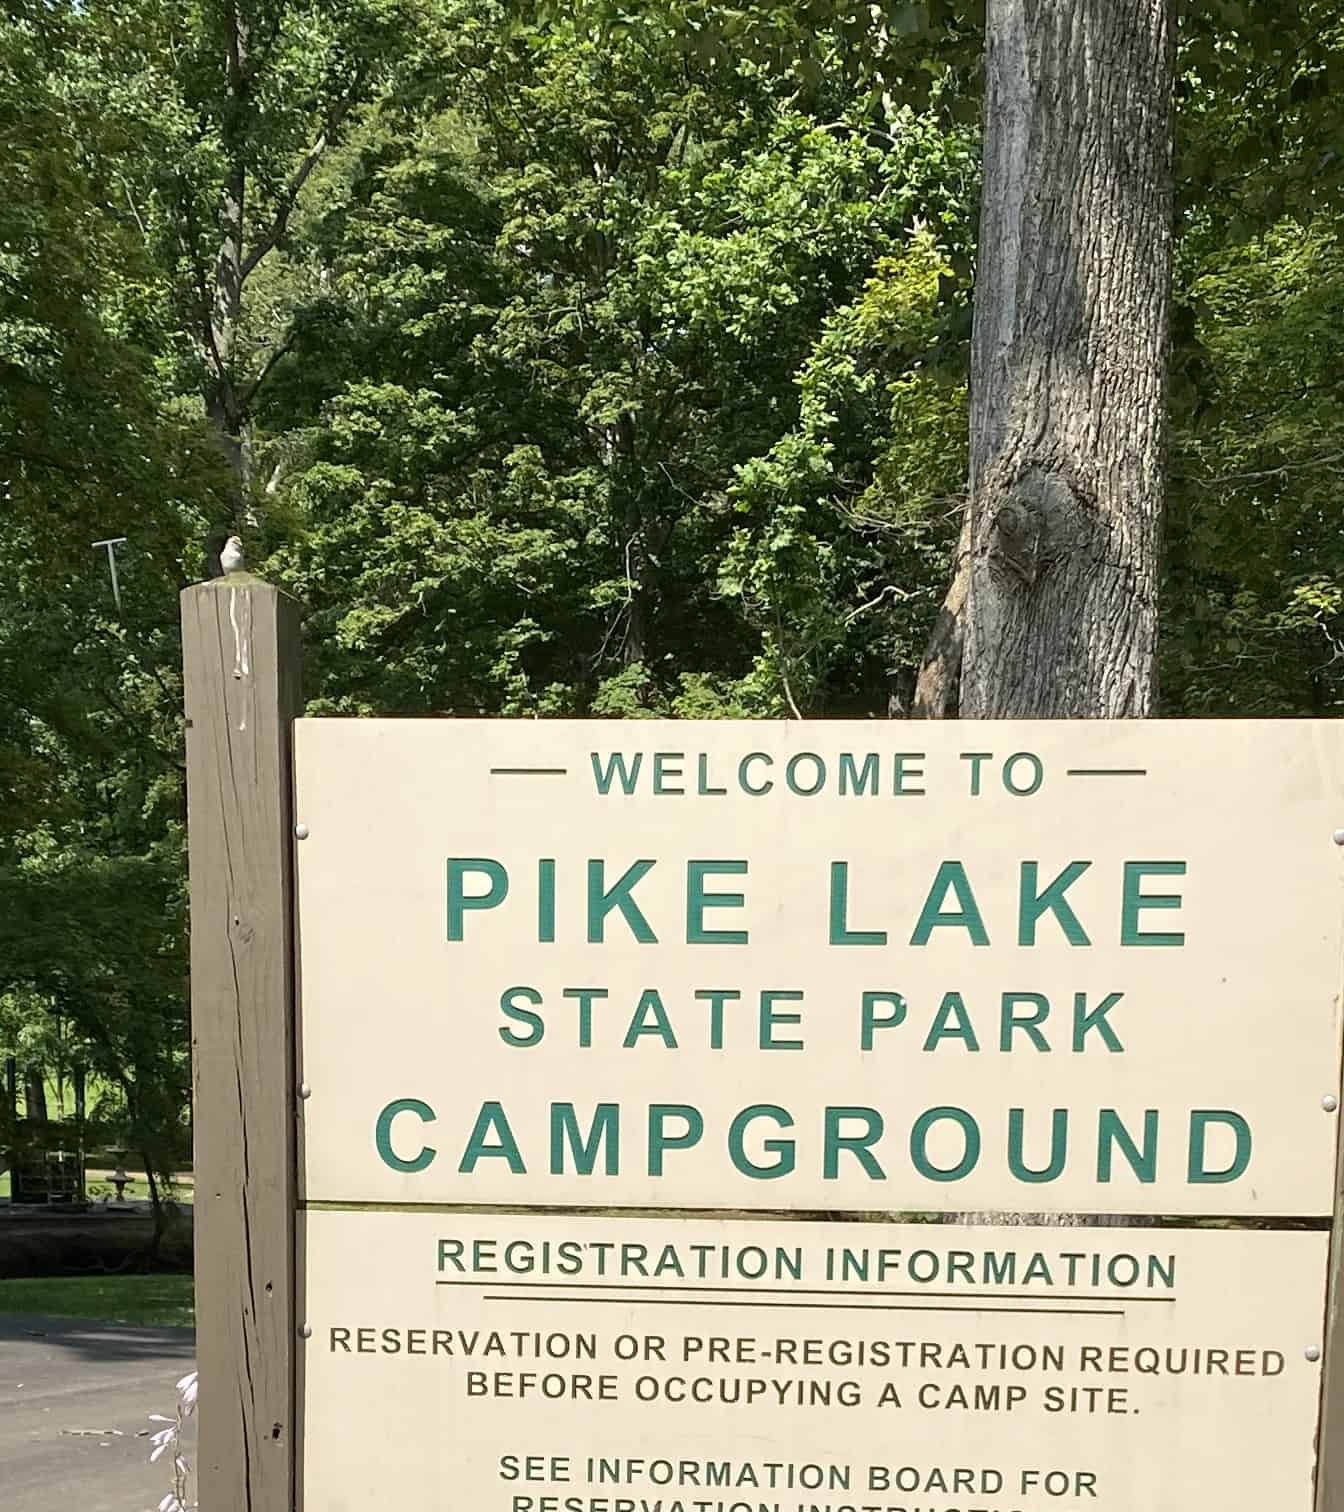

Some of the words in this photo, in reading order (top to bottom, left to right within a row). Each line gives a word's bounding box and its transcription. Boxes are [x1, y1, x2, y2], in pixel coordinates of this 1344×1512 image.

[591, 752, 925, 796] WELCOME
[963, 752, 1043, 796] TO
[447, 858, 748, 944] PIKE
[829, 861, 1186, 946] LAKE
[499, 986, 804, 1050] STATE
[861, 992, 1124, 1052] PARK
[376, 1098, 1251, 1184] CAMPGROUND
[438, 1240, 801, 1280] REGISTRATION
[827, 1248, 1175, 1288] INFORMATION
[331, 1328, 596, 1359] RESERVATION
[615, 1335, 666, 1360] OR
[684, 1337, 1063, 1370] PRE-REGISTRATION
[1081, 1347, 1284, 1376] REQUIRED
[468, 1372, 617, 1400] BEFORE
[636, 1376, 860, 1406] OCCUPYING
[878, 1383, 901, 1408] A
[919, 1384, 1026, 1410] CAMP
[1044, 1387, 1139, 1414] SITE.
[500, 1456, 570, 1482] SEE
[588, 1458, 850, 1489] INFORMATION
[869, 1466, 1002, 1494] BOARD
[1022, 1471, 1096, 1497] FOR
